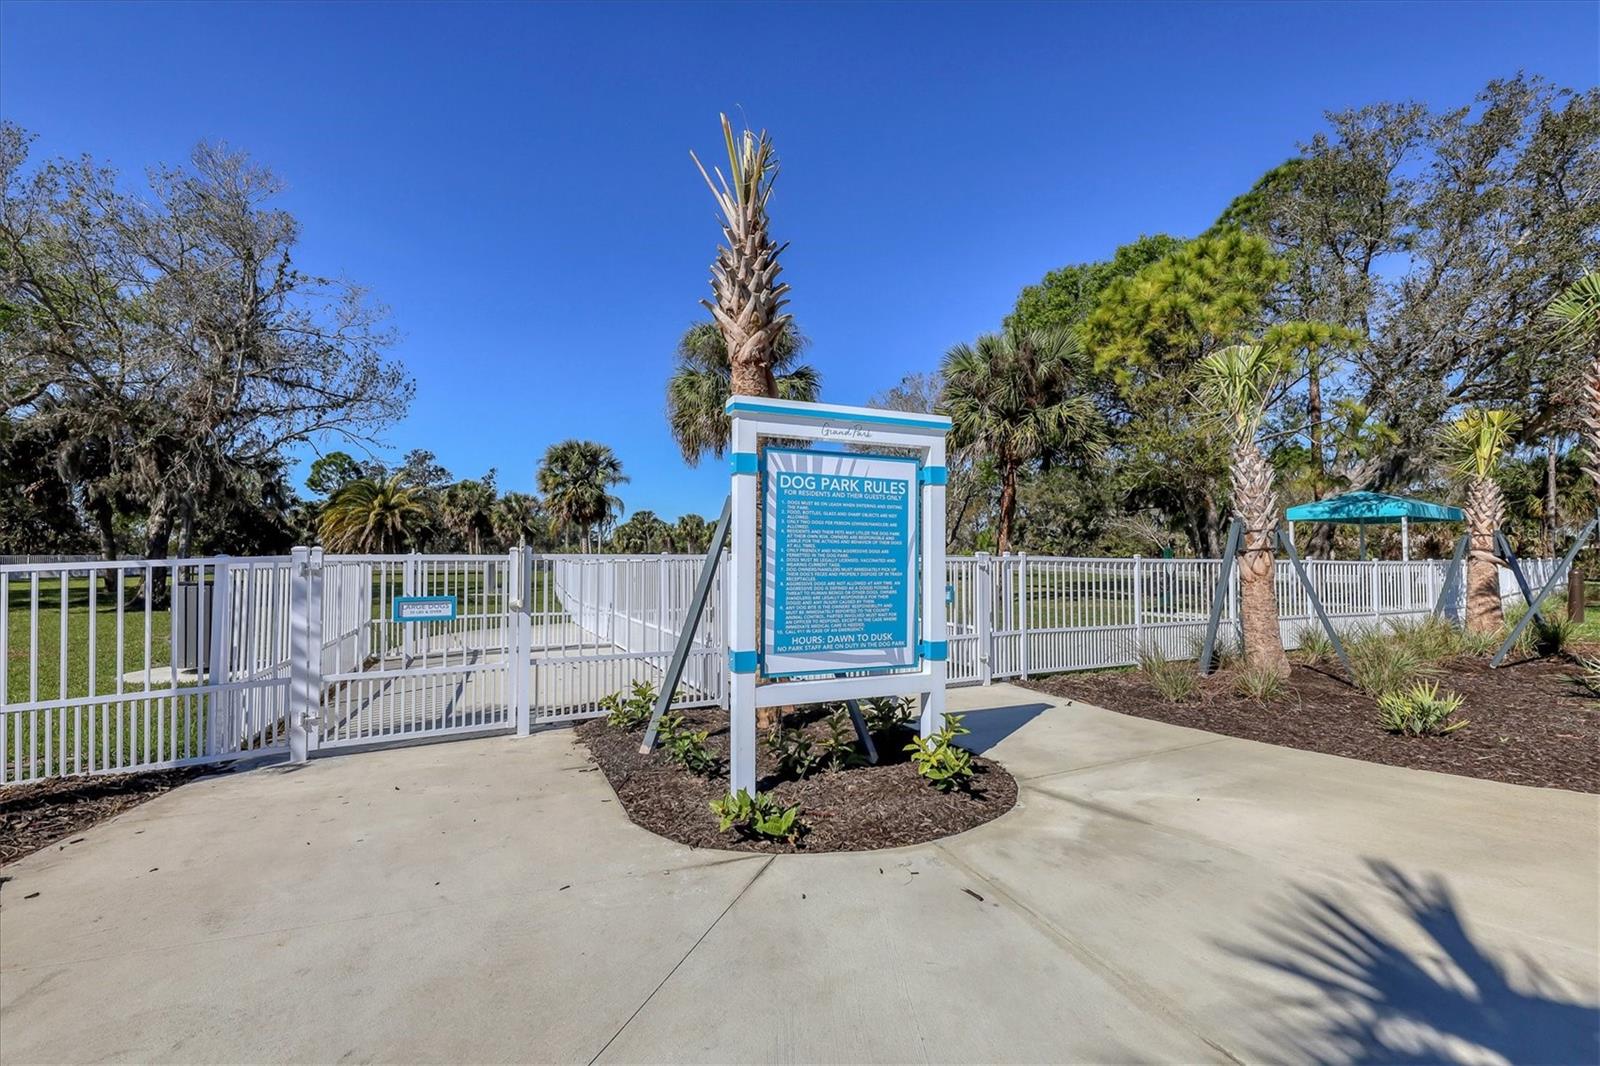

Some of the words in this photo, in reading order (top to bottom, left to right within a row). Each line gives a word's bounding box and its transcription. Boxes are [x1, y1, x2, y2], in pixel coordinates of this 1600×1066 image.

[821, 422, 850, 436] Grand
[852, 424, 872, 438] Park
[780, 475, 816, 489] DOG
[821, 478, 859, 492] PARK
[864, 480, 905, 494] RULES
[791, 635, 825, 644] HOURS:
[826, 634, 855, 643] DAWN
[856, 634, 869, 642] TO
[870, 633, 892, 641] DUSK
